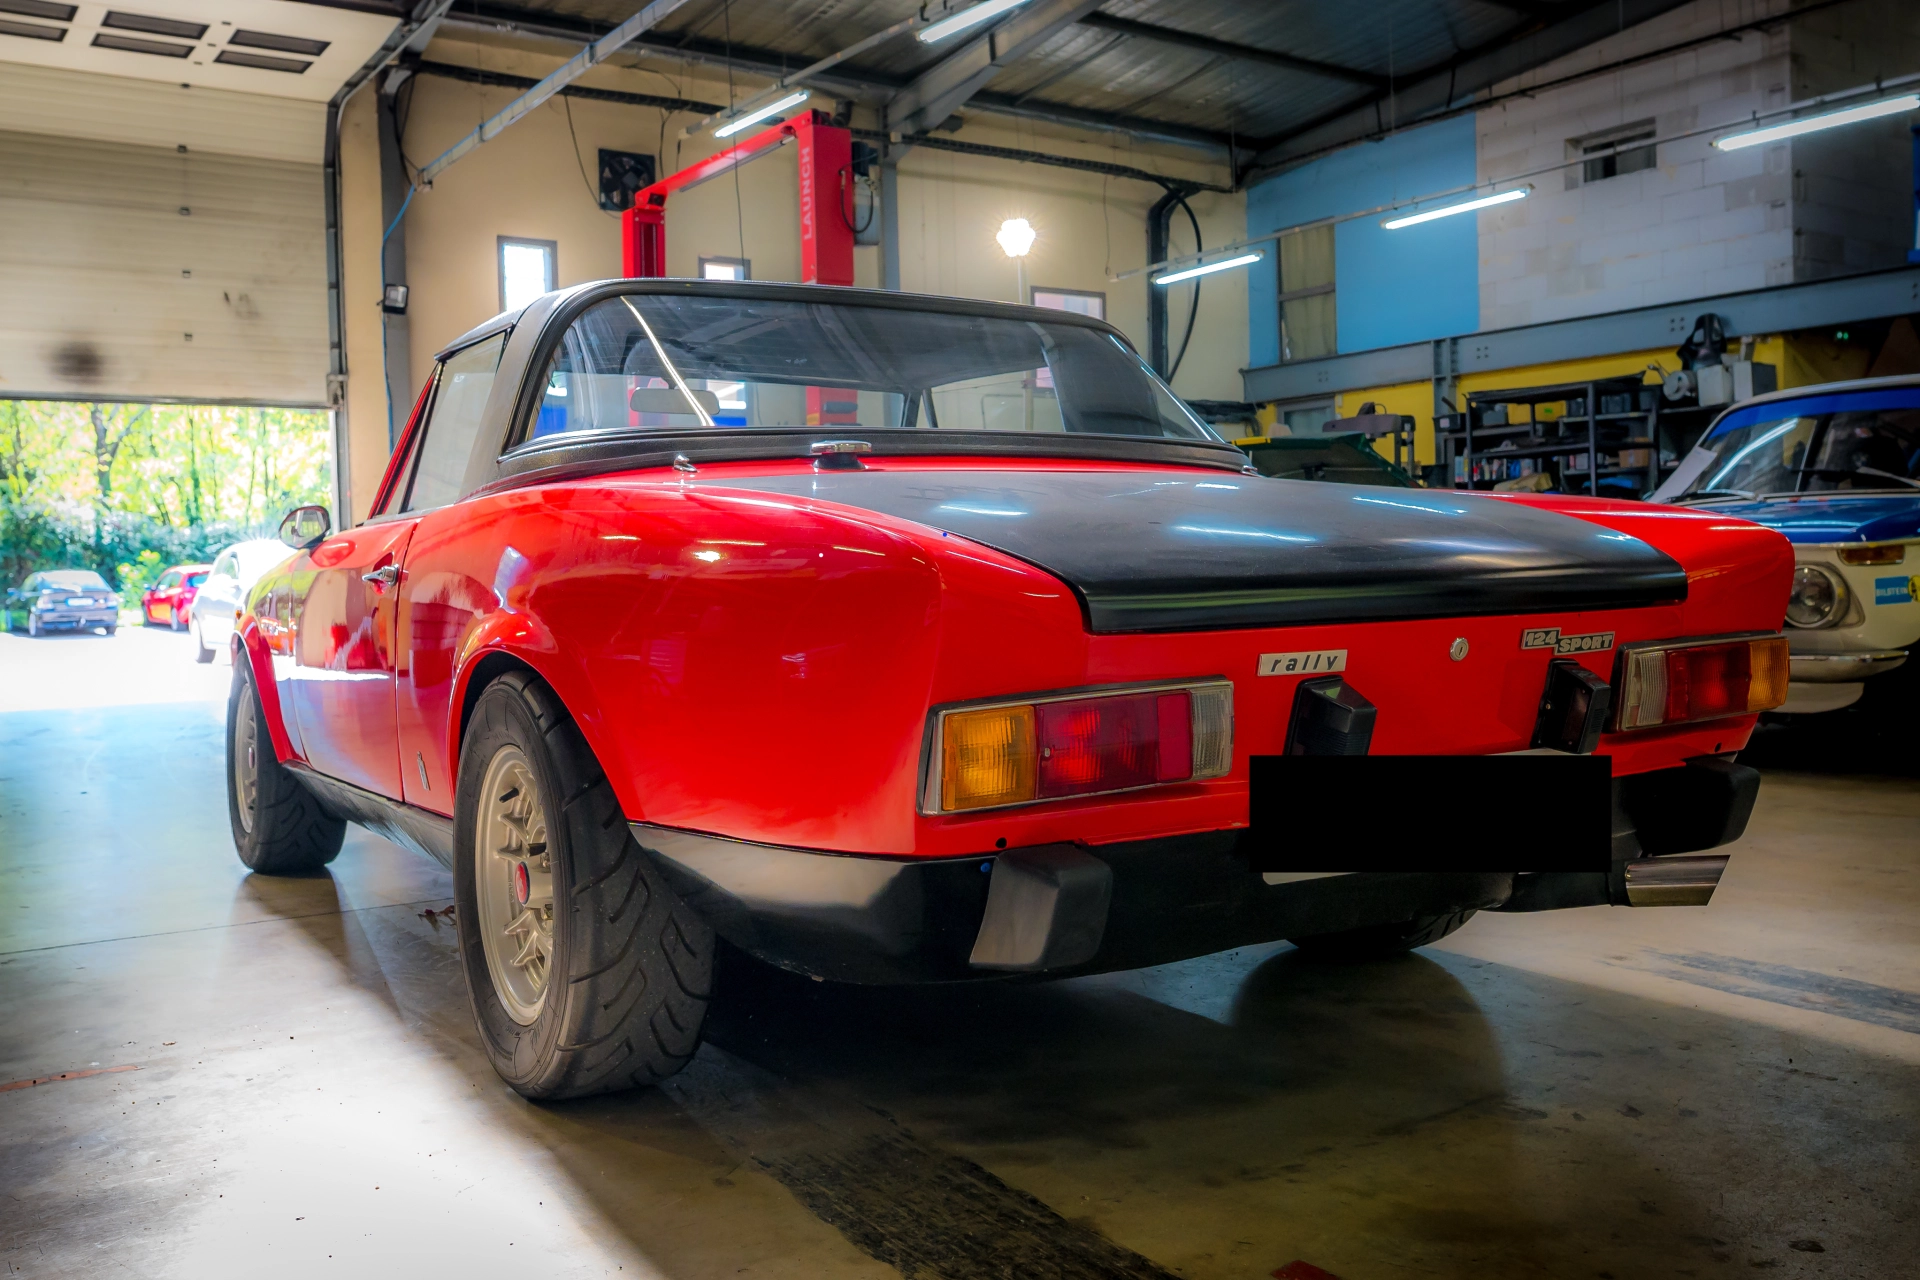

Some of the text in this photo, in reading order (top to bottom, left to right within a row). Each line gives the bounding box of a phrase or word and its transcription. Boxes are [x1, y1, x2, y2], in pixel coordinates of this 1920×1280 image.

[801, 146, 812, 240] LAUNCH
[1526, 630, 1613, 652] 124 SPORT
[1270, 653, 1339, 673] rally
